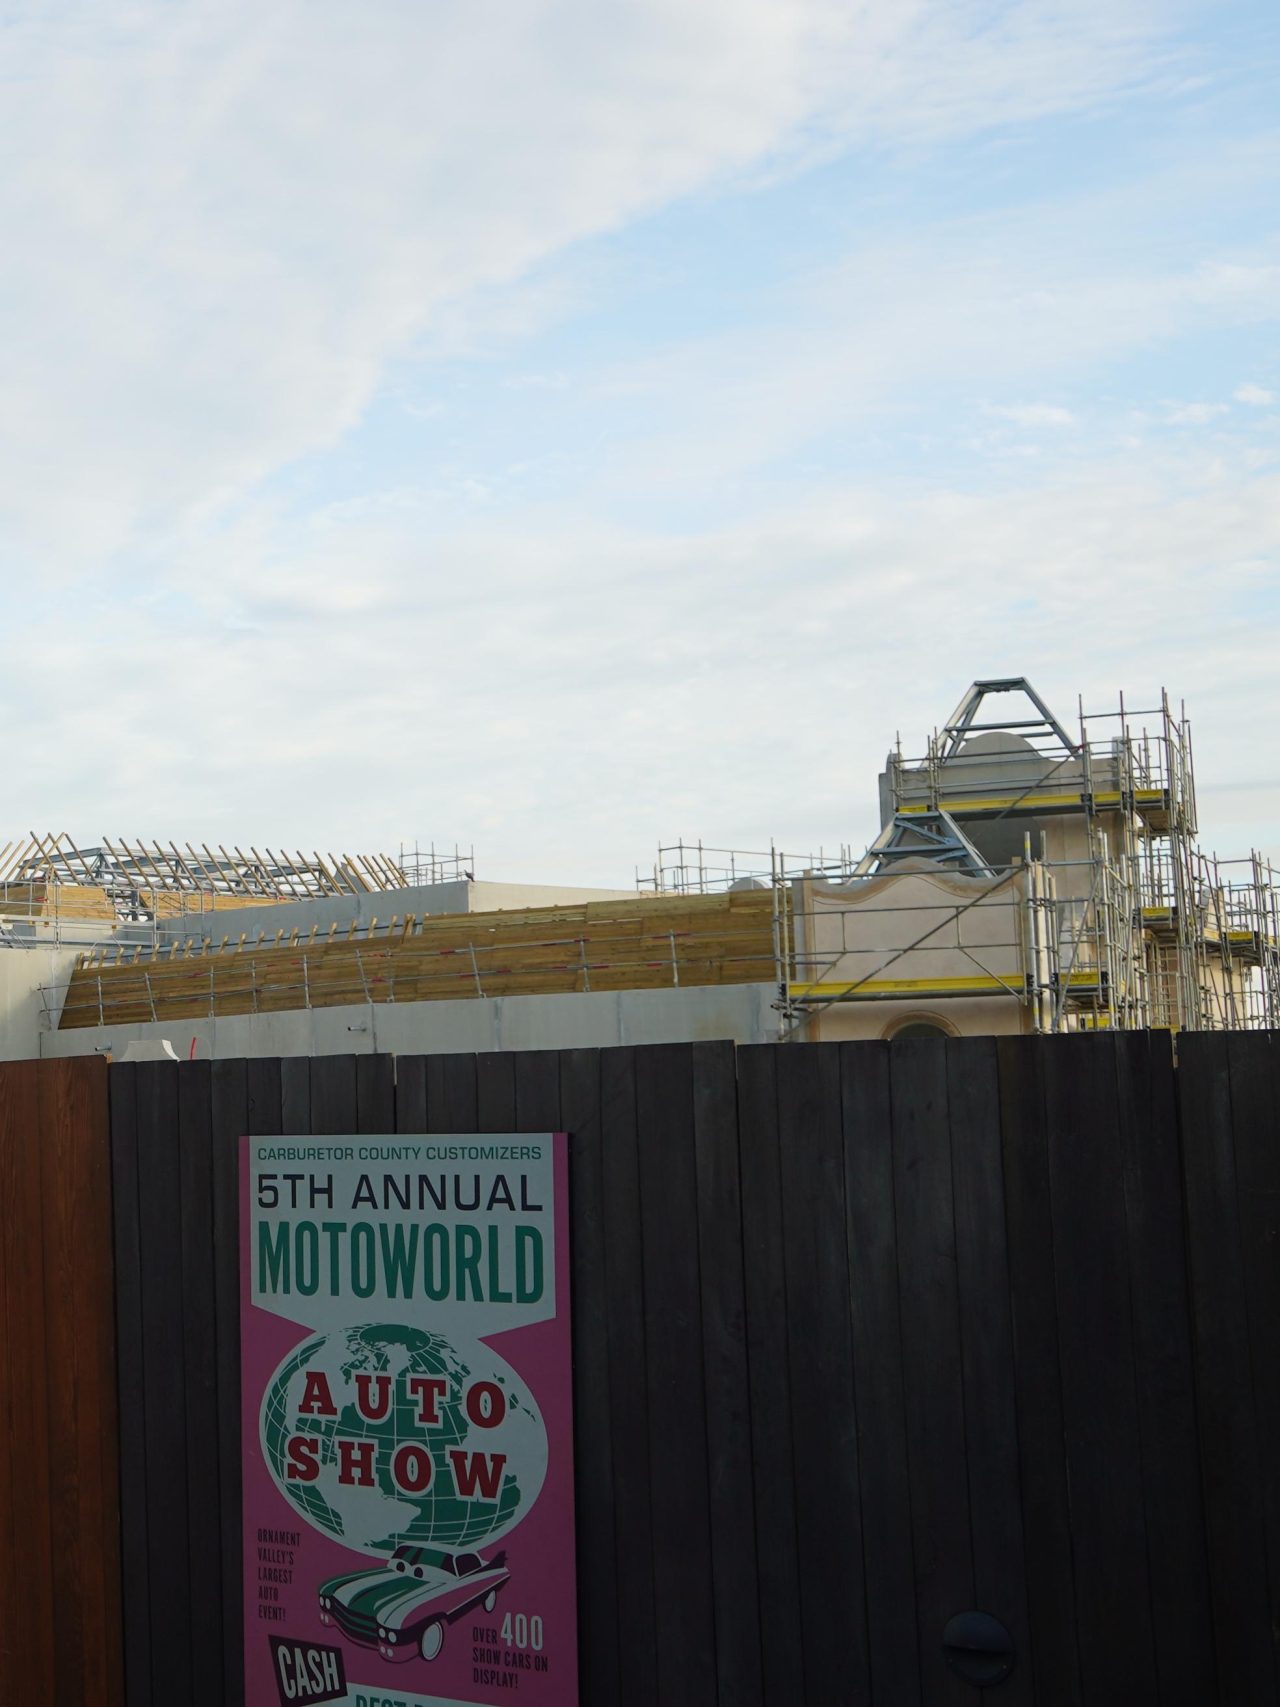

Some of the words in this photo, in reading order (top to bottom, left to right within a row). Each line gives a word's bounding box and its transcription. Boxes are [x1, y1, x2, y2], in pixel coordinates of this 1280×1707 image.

[257, 1147, 354, 1161] CARBURETOR
[359, 1147, 421, 1160] COUNTY
[426, 1146, 542, 1160] CUSTOMIZERS
[258, 1174, 334, 1209] 5TH
[351, 1174, 543, 1211] ANNUAL
[258, 1221, 544, 1304] MOTOWORLD
[298, 1371, 506, 1429] AUTO
[287, 1436, 507, 1499] SHOW
[257, 1528, 301, 1547] ORNAMENT
[257, 1548, 294, 1565] VALLEY'S
[258, 1567, 293, 1584] LARGEST
[258, 1586, 279, 1602] AUTO
[258, 1605, 286, 1622] EVENT!
[473, 1626, 497, 1644] OVER
[500, 1612, 544, 1651] 400
[277, 1645, 340, 1699] CASH
[473, 1647, 501, 1665] SHOW
[504, 1651, 531, 1670] CARS
[534, 1655, 548, 1673] ON
[473, 1667, 518, 1689] DISPLAY!
